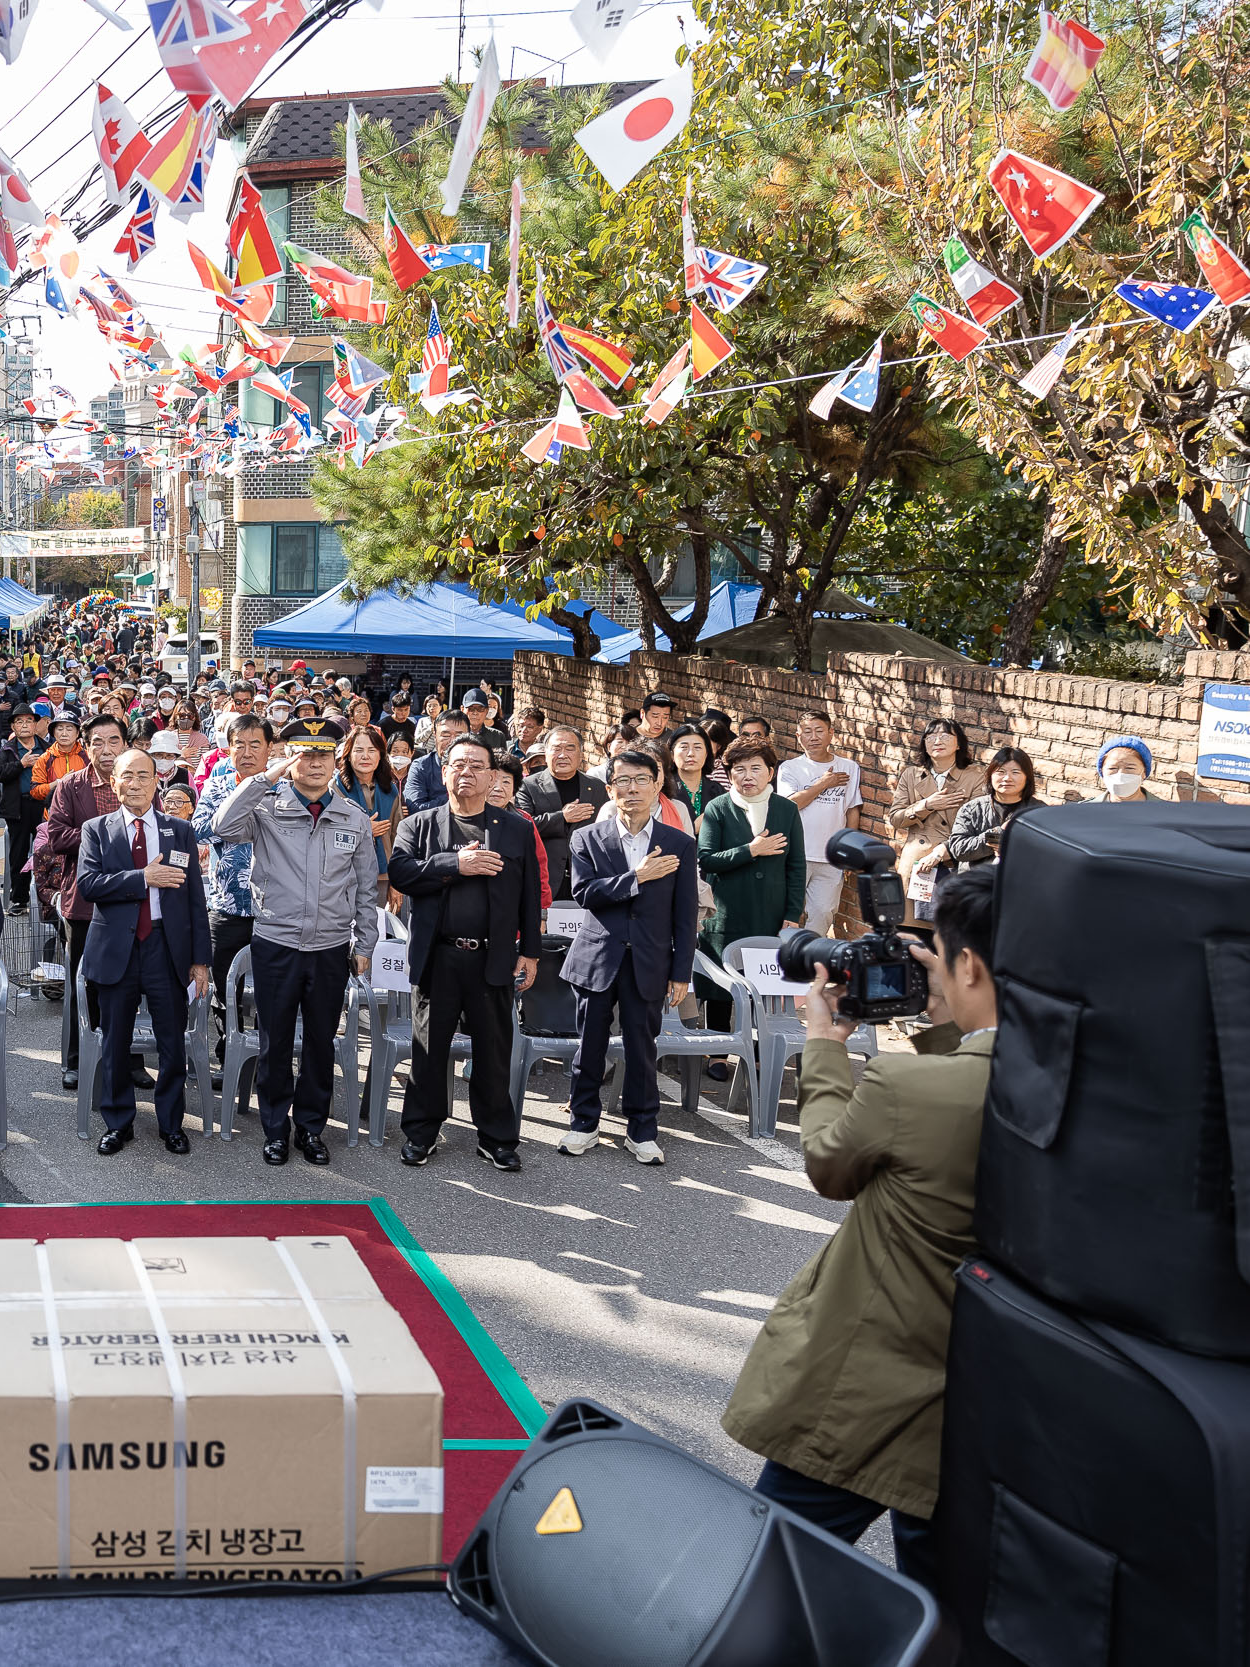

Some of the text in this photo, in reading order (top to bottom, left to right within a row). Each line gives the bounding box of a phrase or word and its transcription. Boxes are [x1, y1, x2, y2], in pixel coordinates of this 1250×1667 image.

[381, 957, 405, 972] 경찰
[249, 1332, 350, 1344] KMCHI
[181, 1350, 236, 1367] 김치
[244, 1349, 298, 1364] 삼성
[28, 1440, 226, 1472] SAMSUNG
[91, 1528, 306, 1558] 삼성 김치 냉장고
